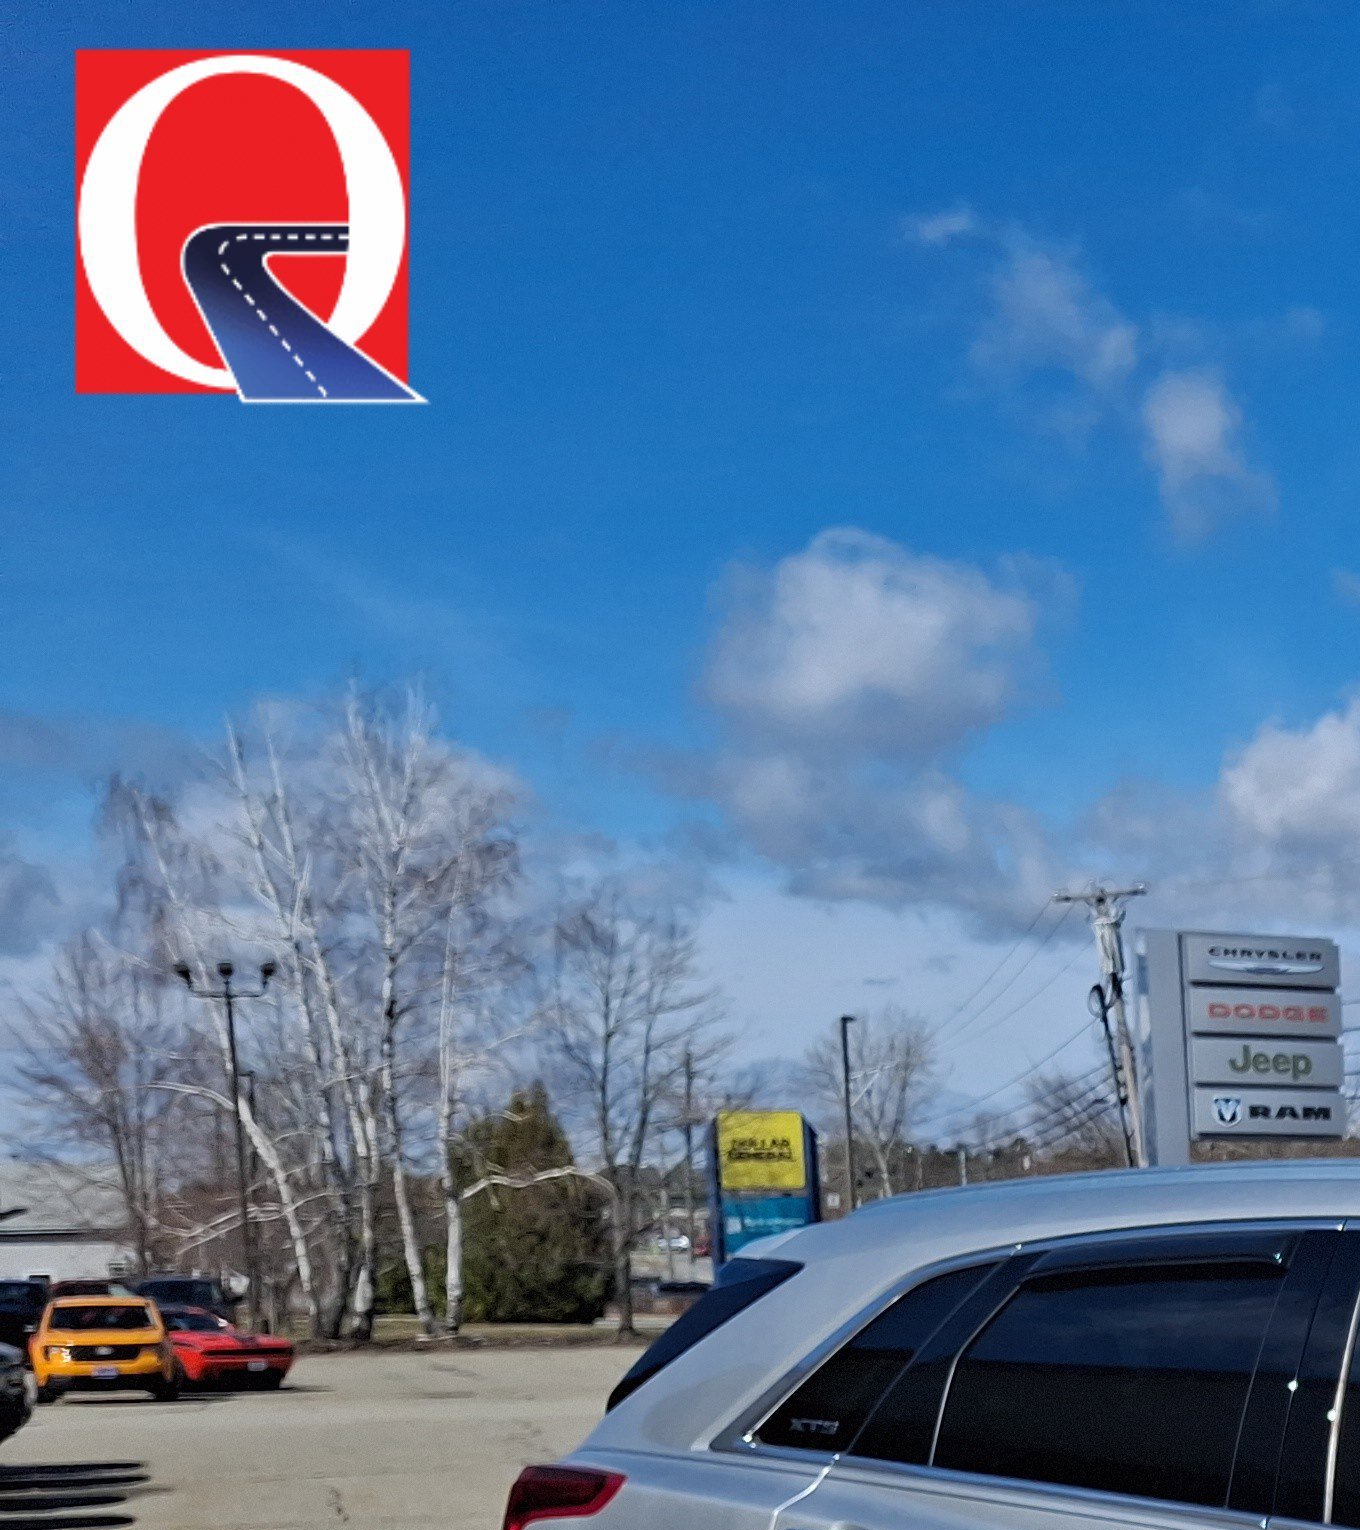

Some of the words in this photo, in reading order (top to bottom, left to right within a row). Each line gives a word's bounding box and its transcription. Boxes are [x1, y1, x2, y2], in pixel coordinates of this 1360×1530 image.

[1208, 945, 1323, 961] CHRYSLER
[1206, 1002, 1330, 1023] DODGE
[1228, 1045, 1313, 1080] Jeep
[1248, 1105, 1332, 1121] RAM
